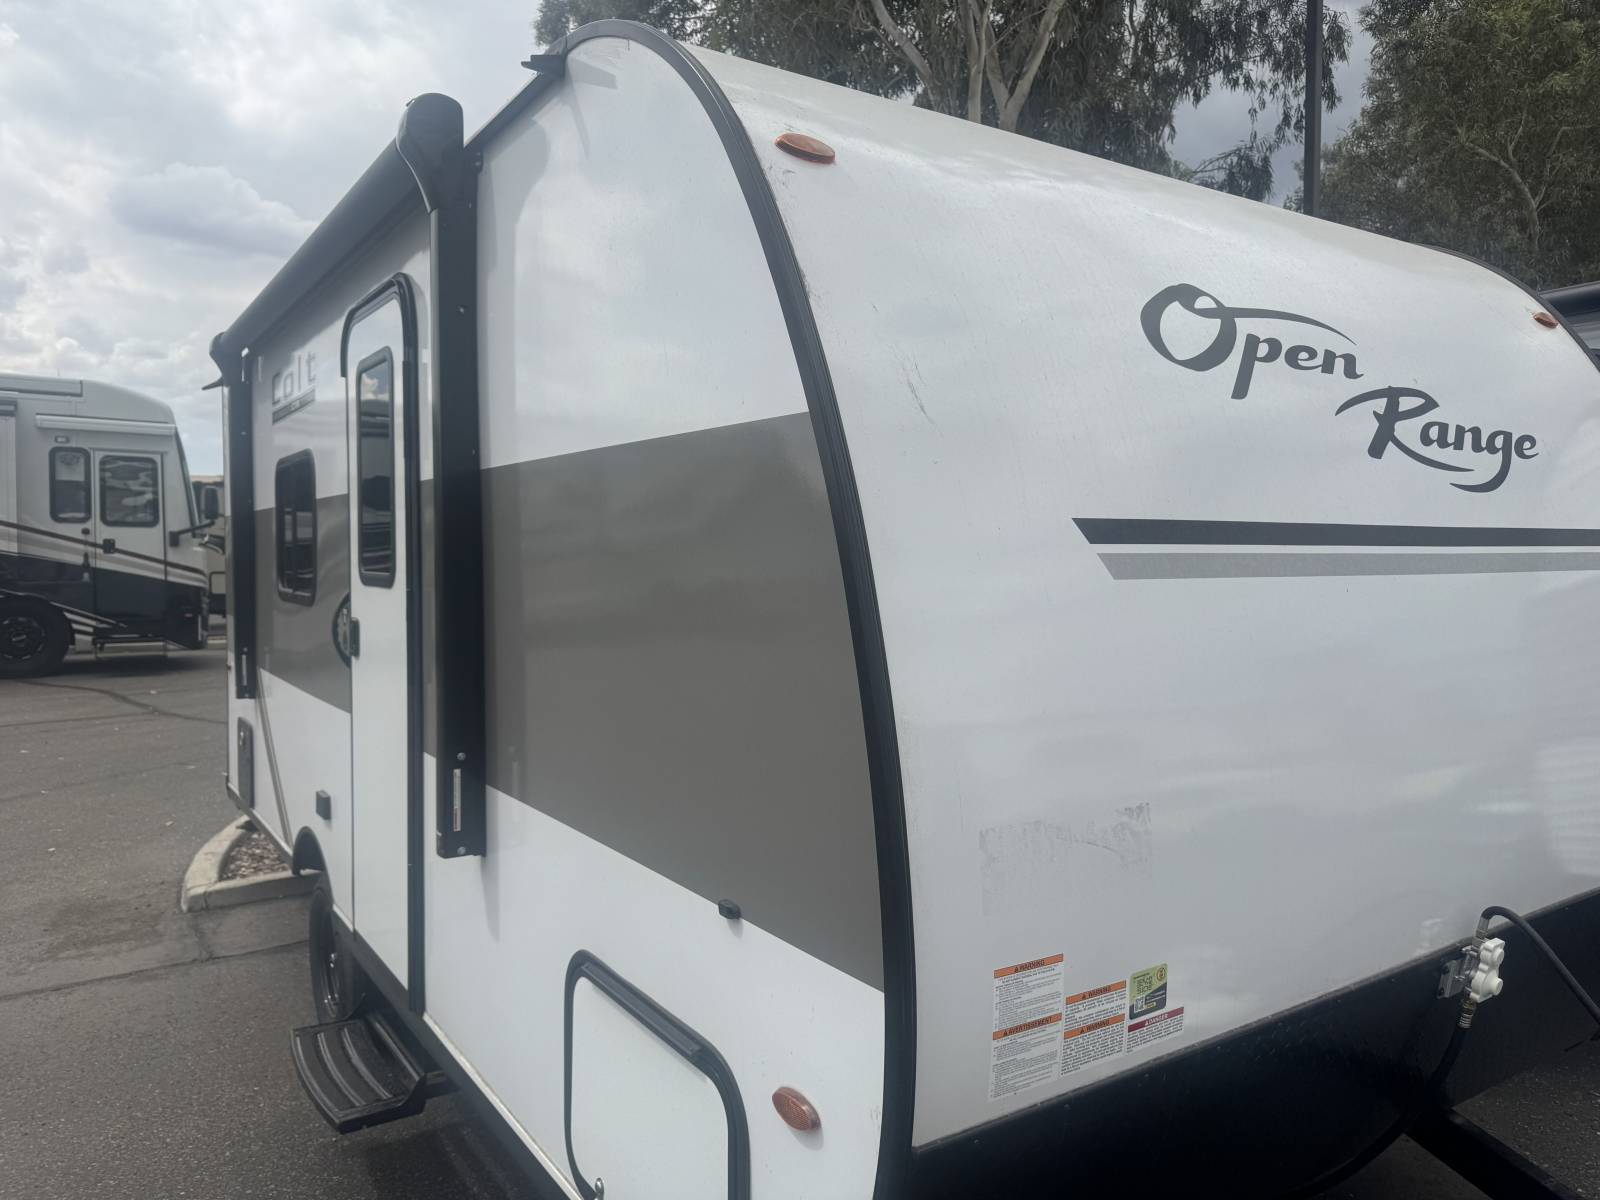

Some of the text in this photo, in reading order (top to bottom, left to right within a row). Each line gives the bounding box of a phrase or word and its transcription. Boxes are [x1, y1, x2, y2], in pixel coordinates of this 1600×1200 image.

[1141, 283, 1364, 399] Open
[1334, 385, 1539, 493] Range
[1020, 959, 1045, 972] WARNING
